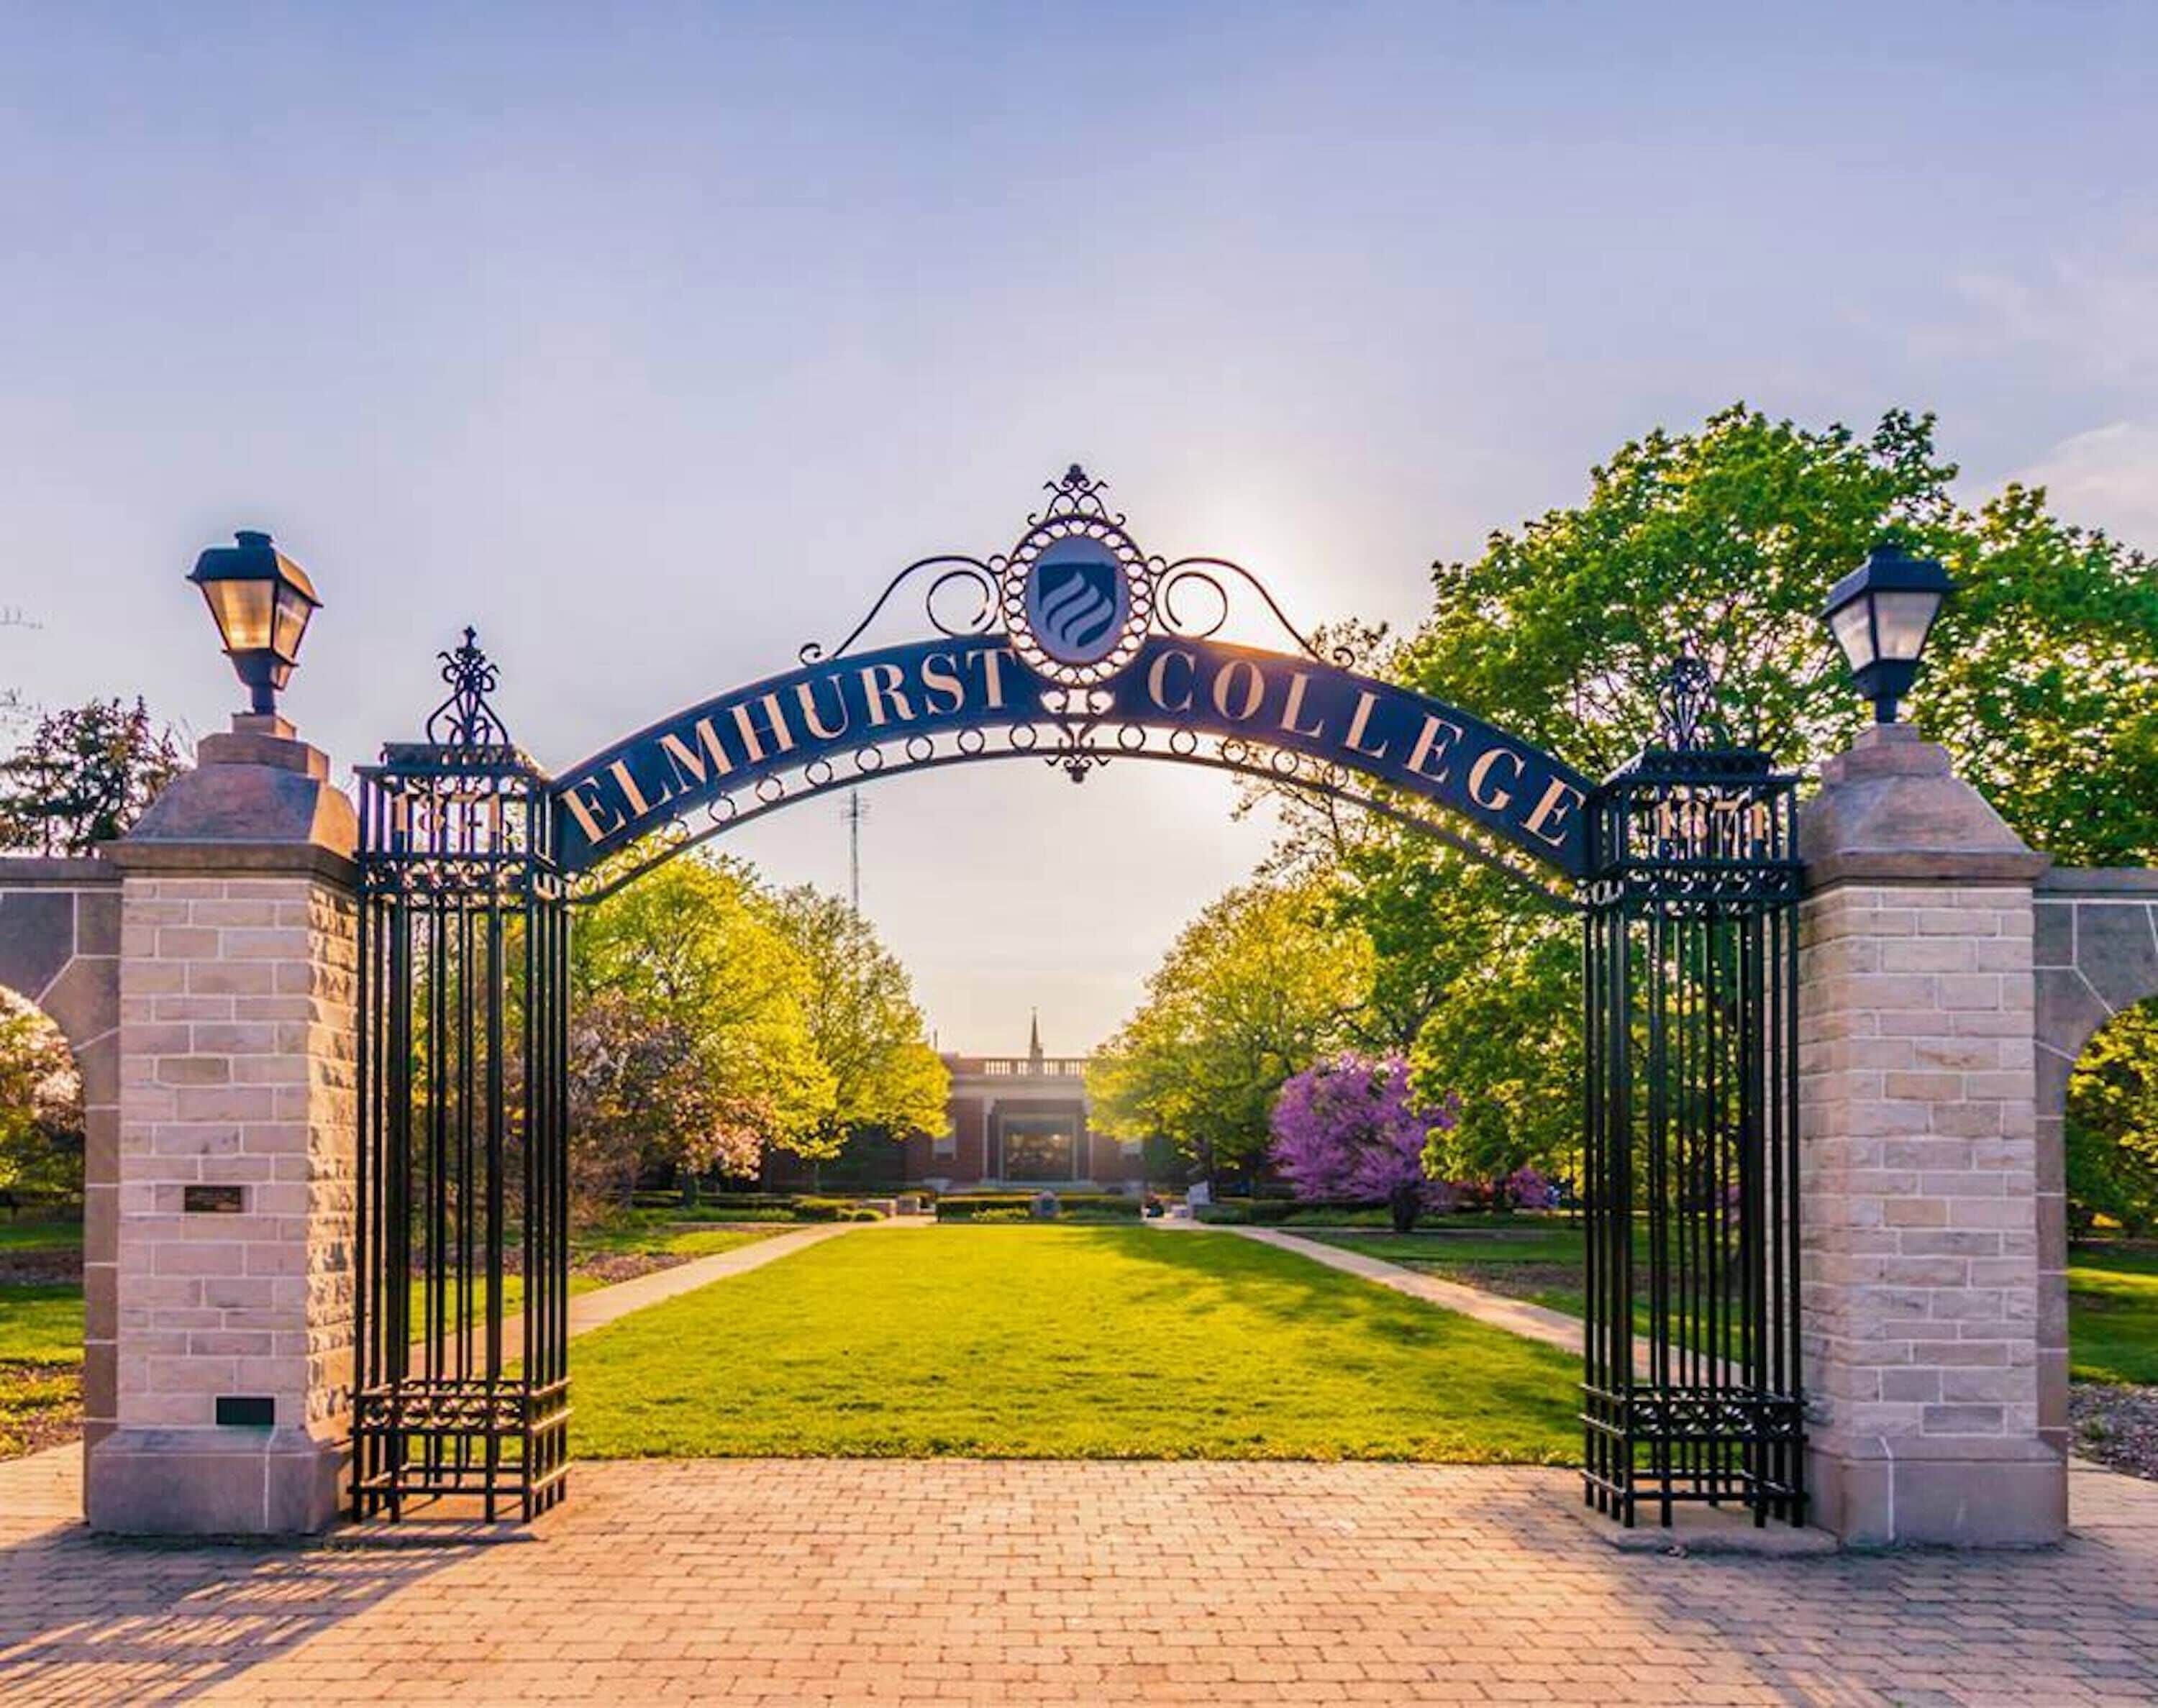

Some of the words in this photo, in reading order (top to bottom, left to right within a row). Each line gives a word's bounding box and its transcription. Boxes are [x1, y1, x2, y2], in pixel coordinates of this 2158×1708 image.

[560, 647, 1017, 845] ELMHURST
[1149, 649, 1585, 847] COLLEGE
[1654, 798, 1765, 840] 1871
